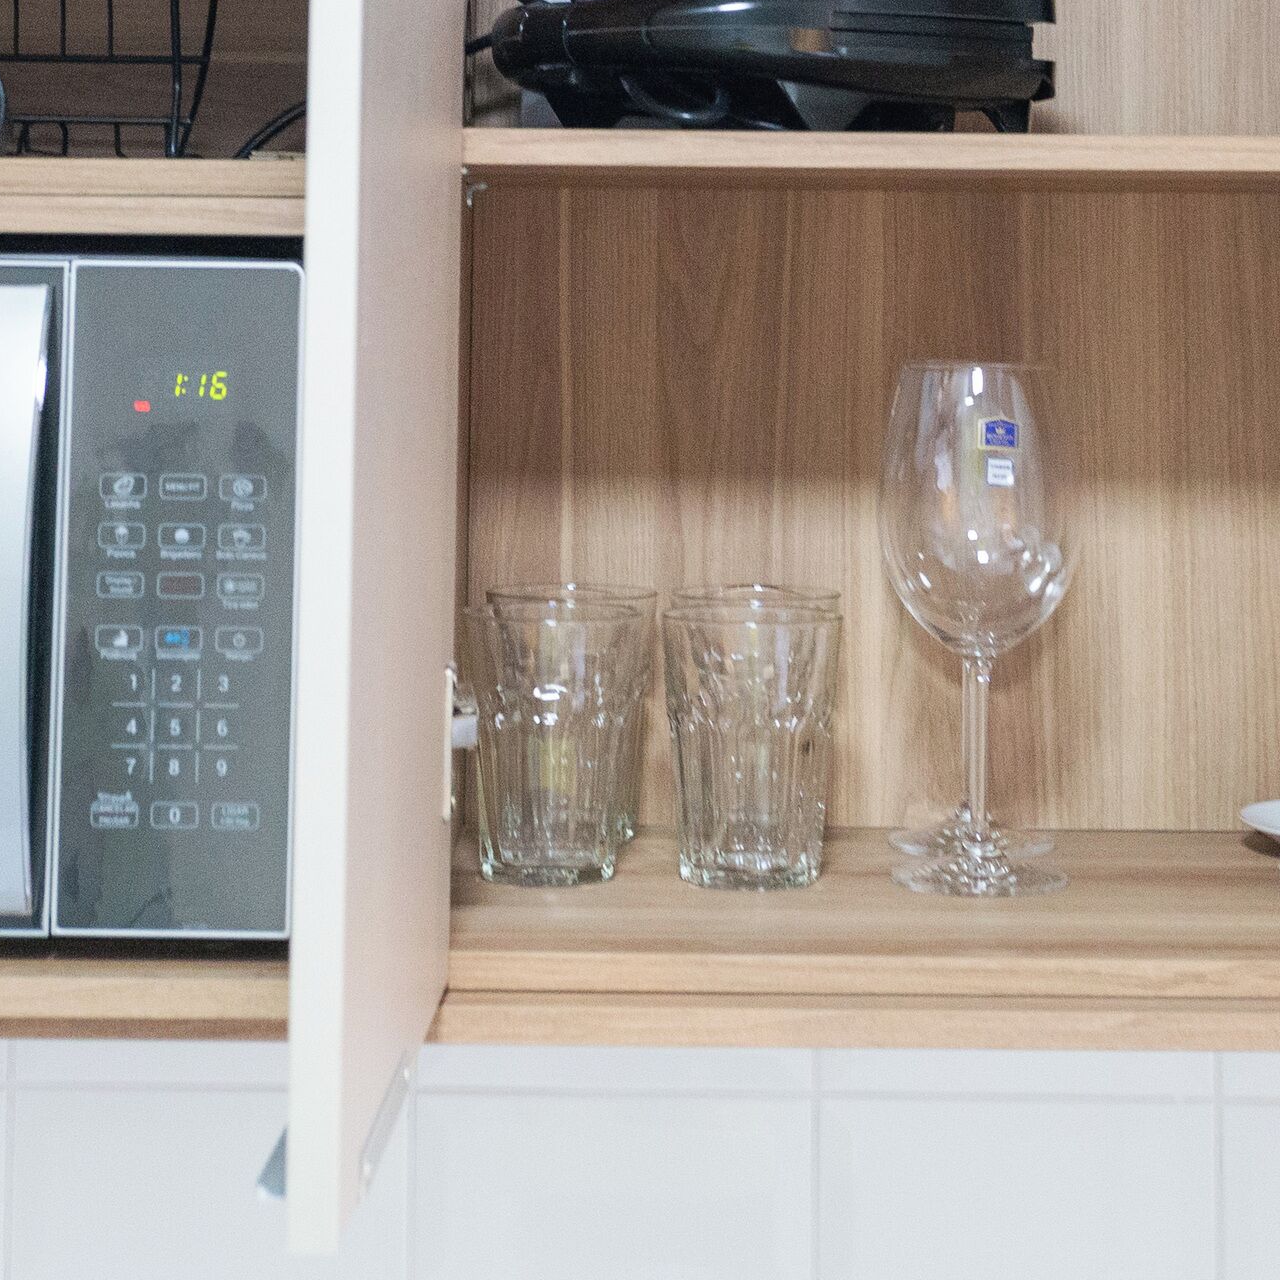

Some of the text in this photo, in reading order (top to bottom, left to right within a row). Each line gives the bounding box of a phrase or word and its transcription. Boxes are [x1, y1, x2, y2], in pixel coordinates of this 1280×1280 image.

[175, 370, 228, 401] 1:16
[130, 673, 229, 692] 1 2 3
[126, 718, 137, 736] 4
[217, 719, 228, 737] 6
[126, 757, 227, 777] 7 8 9
[169, 806, 181, 824] 0
